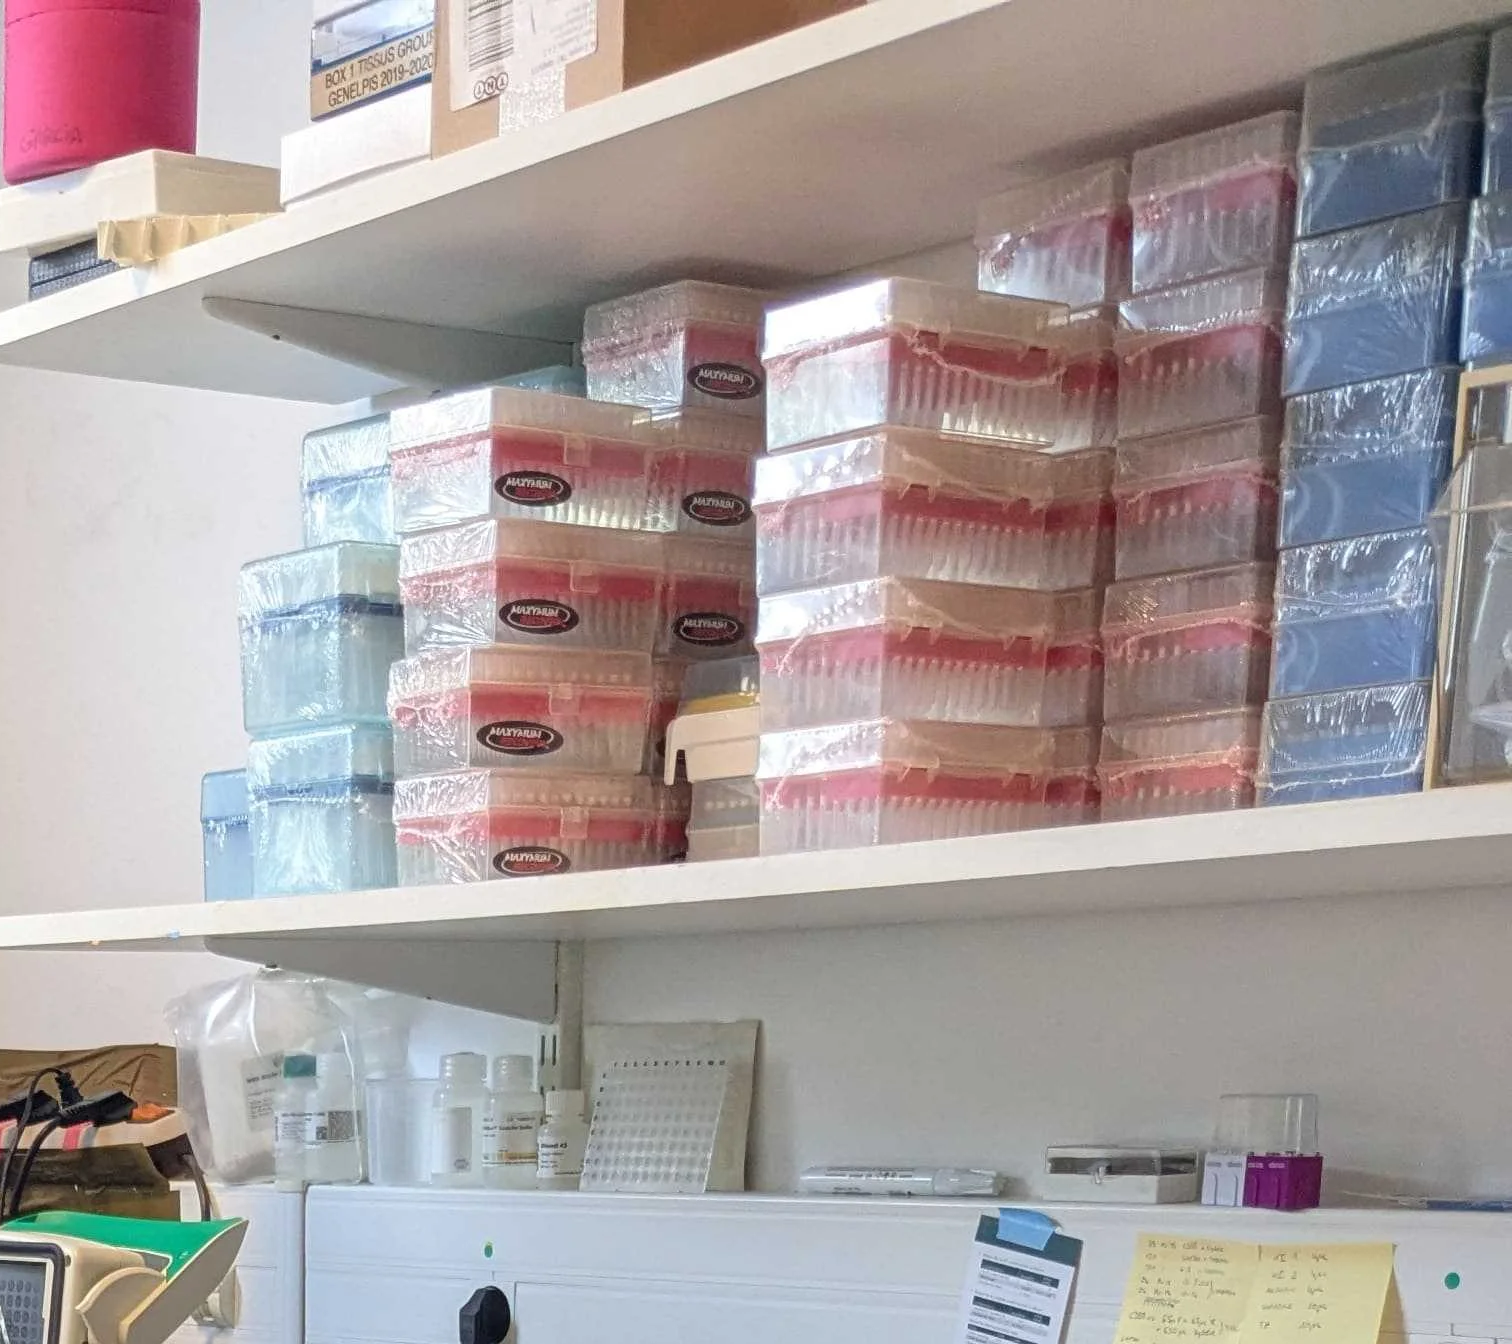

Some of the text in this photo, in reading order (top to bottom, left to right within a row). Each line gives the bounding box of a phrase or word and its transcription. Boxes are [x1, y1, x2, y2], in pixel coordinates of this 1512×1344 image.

[325, 70, 346, 88] BOX
[358, 47, 395, 74] TISSUS
[328, 76, 378, 107] GENELPIS
